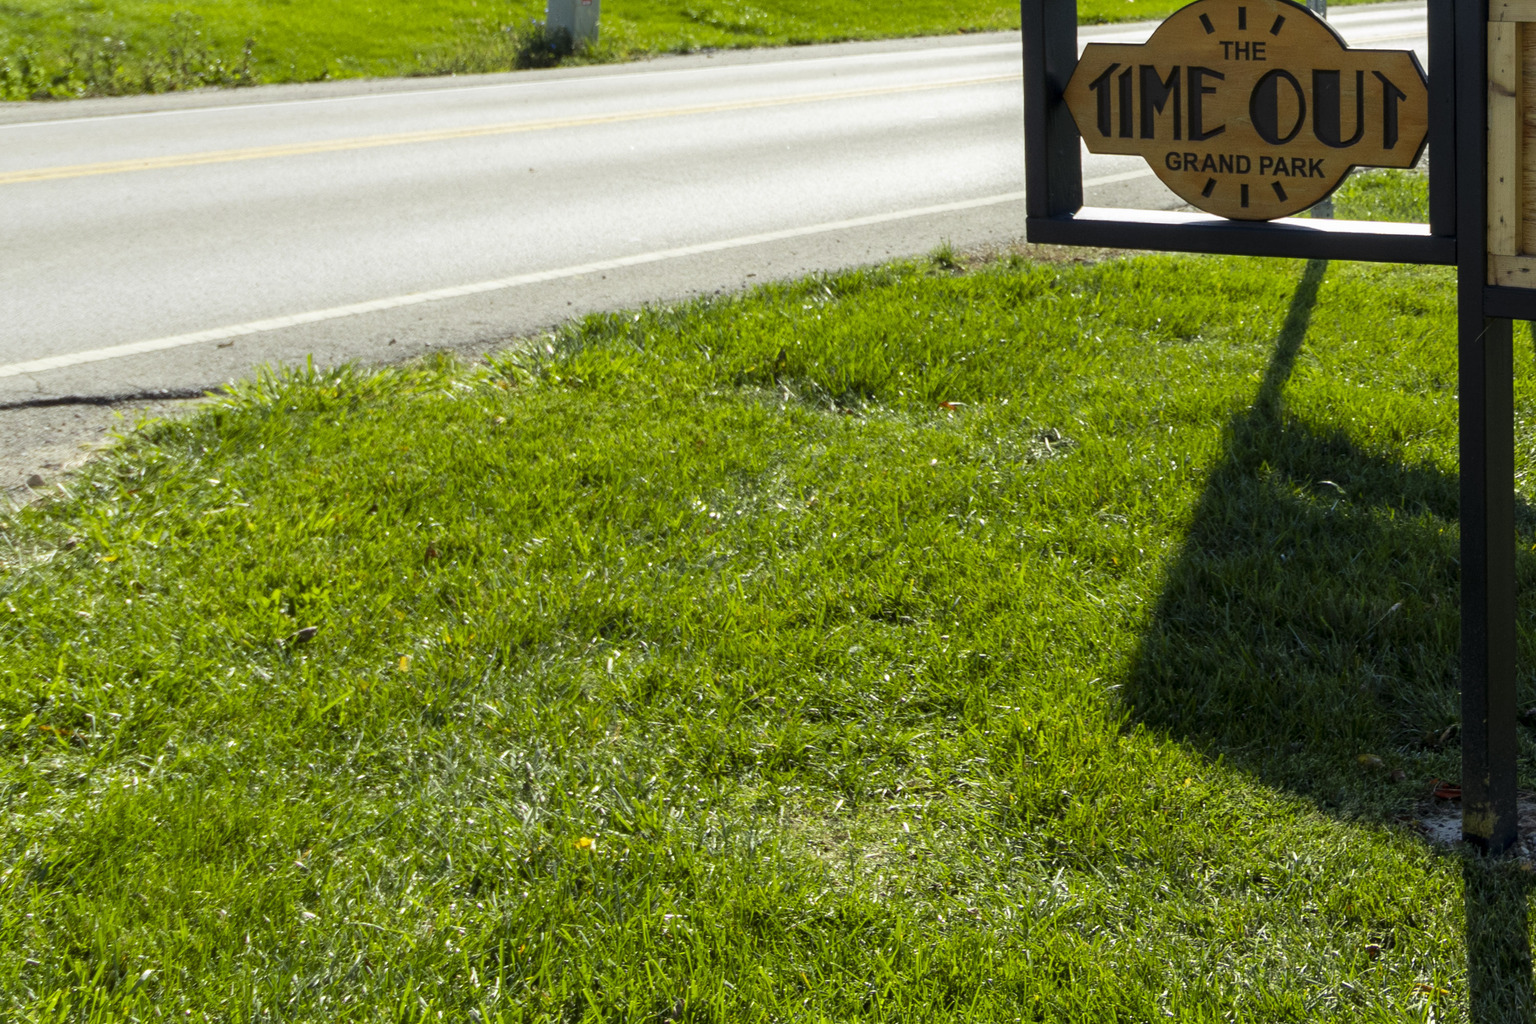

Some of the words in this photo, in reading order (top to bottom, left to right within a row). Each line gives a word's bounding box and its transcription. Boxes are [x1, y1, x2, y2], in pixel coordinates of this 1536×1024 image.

[1219, 40, 1267, 62] THE
[1088, 62, 1227, 142] TIME
[1249, 68, 1408, 150] OUT
[1165, 151, 1252, 174] GRAND
[1259, 156, 1327, 179] PARK
